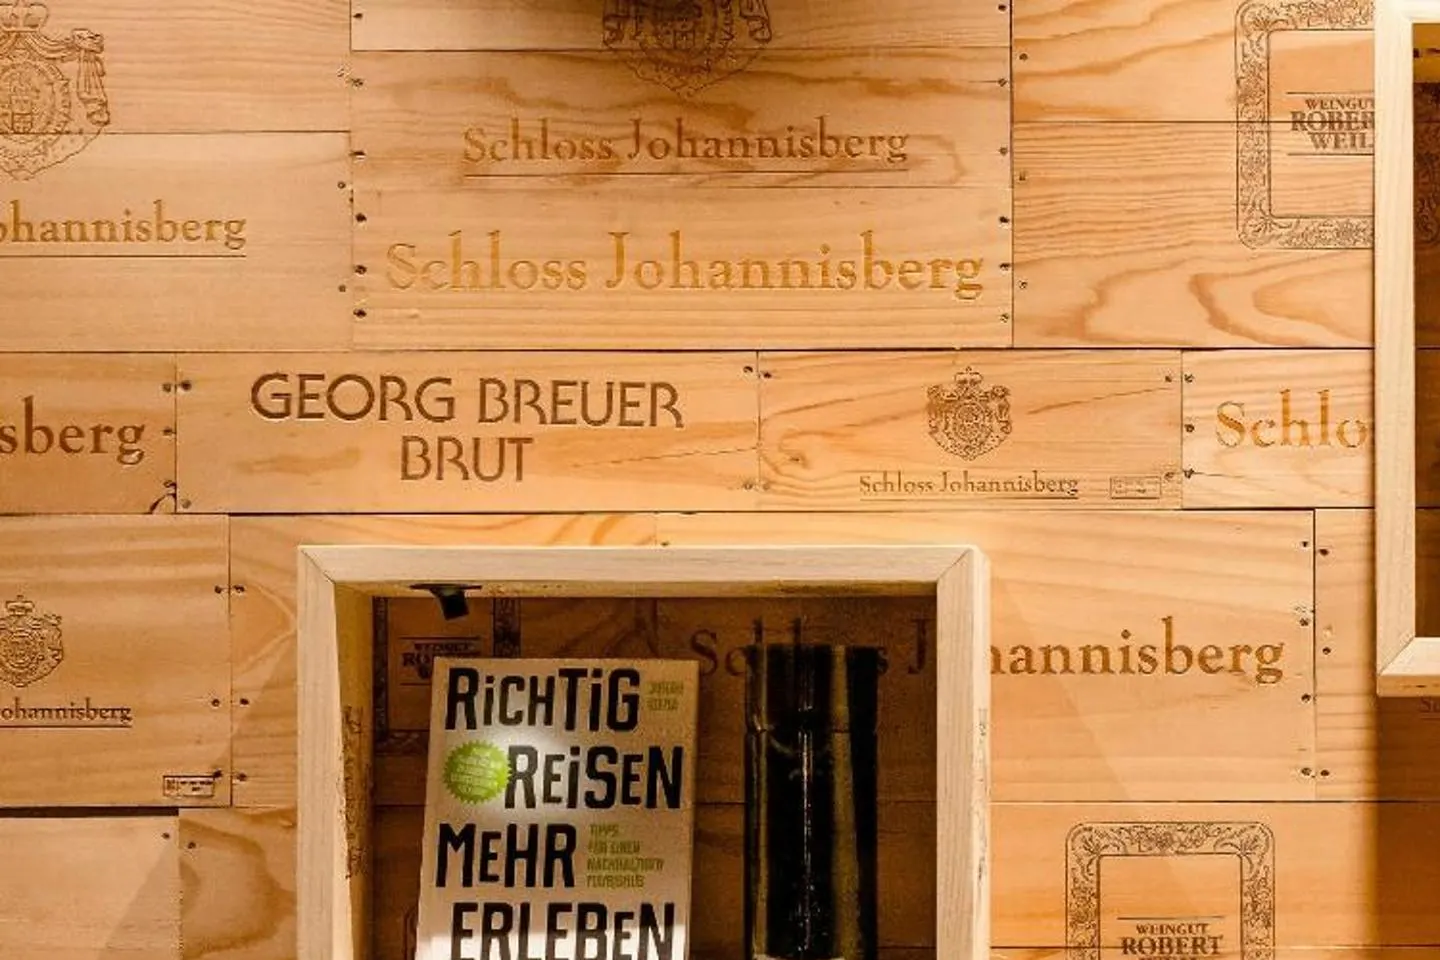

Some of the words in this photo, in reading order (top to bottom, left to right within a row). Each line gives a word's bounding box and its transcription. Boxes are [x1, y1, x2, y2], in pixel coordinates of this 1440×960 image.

[463, 117, 612, 164] Schloss
[628, 116, 909, 165] Johannisberg
[386, 231, 588, 292] Schloss
[605, 230, 984, 300] Johannisberg
[250, 372, 457, 422] GEORG
[477, 380, 684, 430] BREUER
[1216, 388, 1369, 448] Schlo
[400, 436, 533, 483] BRUT
[859, 471, 934, 493] Schloss
[940, 470, 1079, 496] Johannisberg
[0, 697, 132, 722] ohannisberg
[435, 823, 577, 888] MEHR
[1120, 935, 1223, 955] ROBERT
[1136, 923, 1209, 934] WEINGUT
